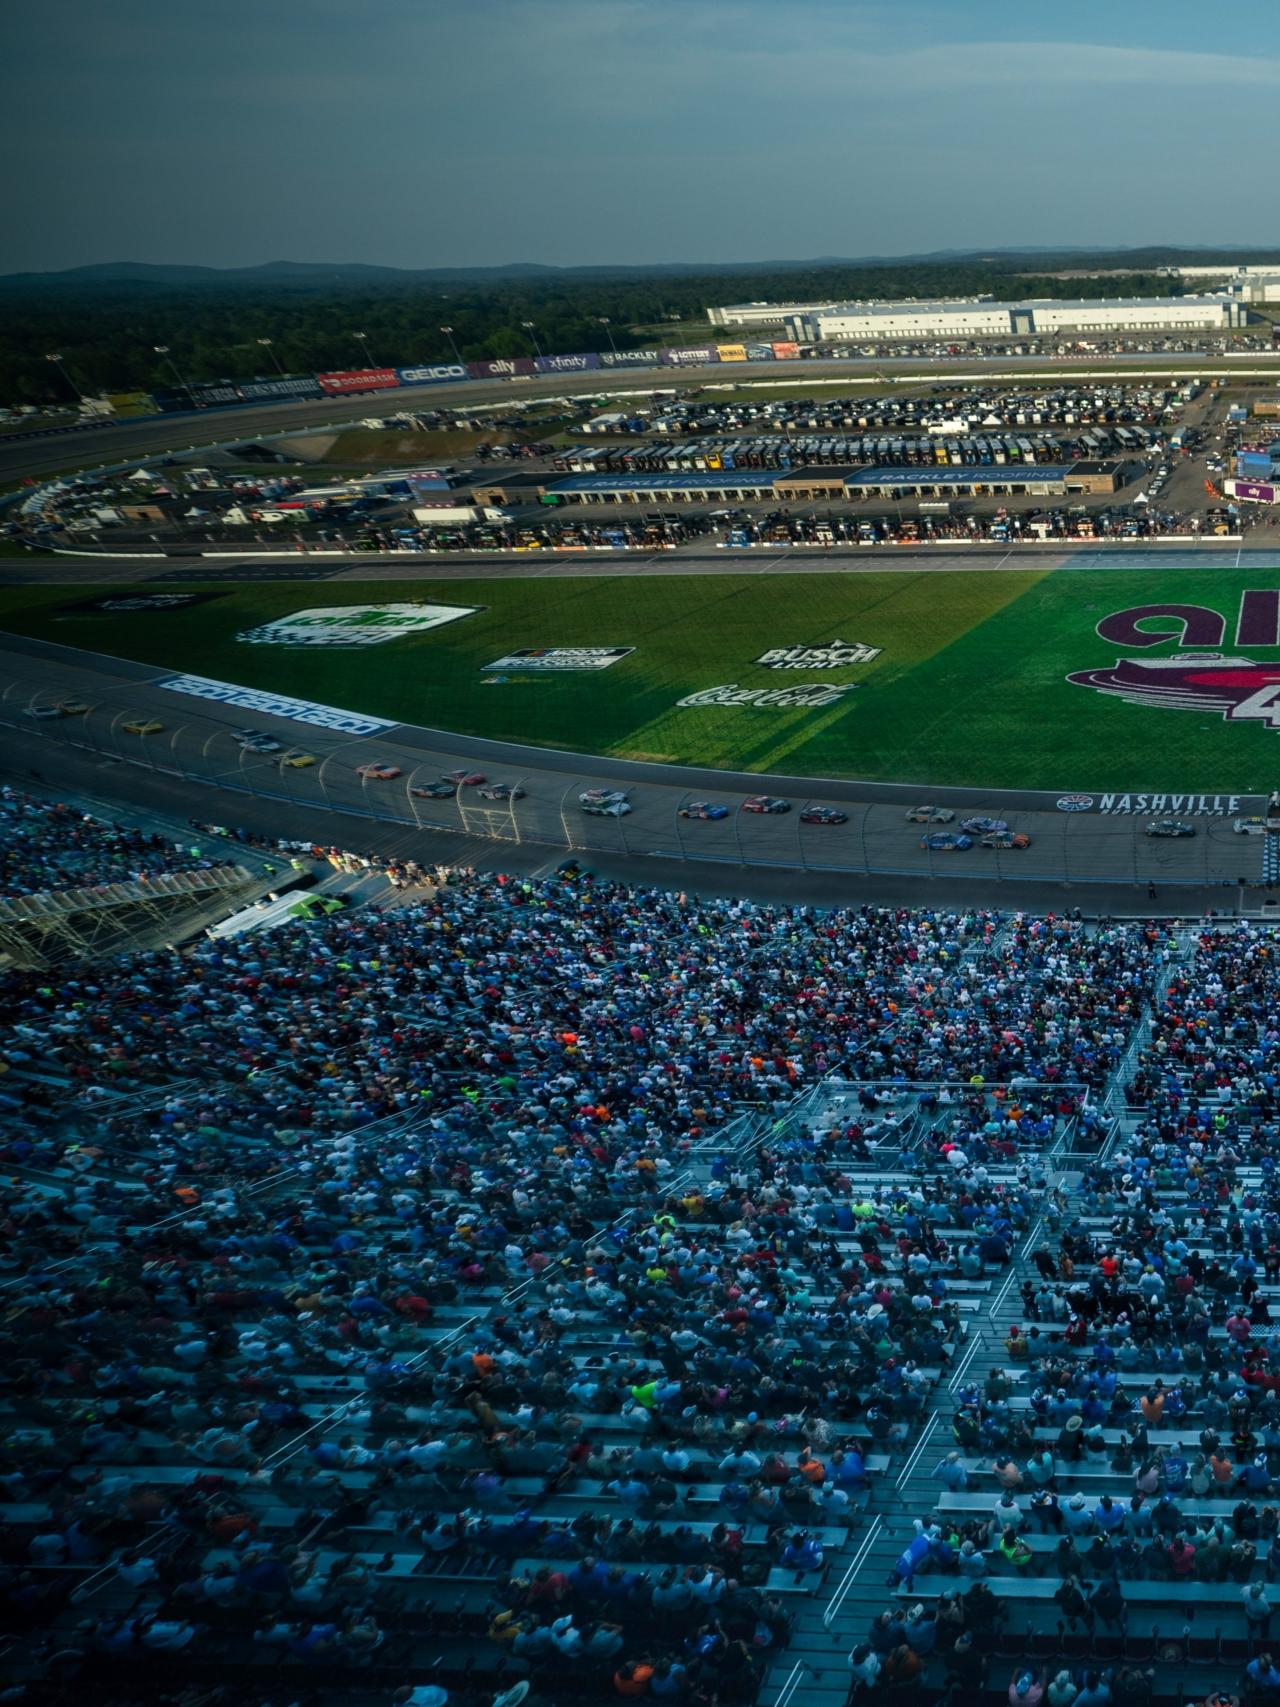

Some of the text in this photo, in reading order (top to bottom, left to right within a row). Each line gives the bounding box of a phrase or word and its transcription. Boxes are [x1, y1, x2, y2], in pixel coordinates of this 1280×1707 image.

[615, 351, 657, 361] RACKLEY
[678, 350, 710, 358] LOTTERY
[488, 360, 515, 374] ally
[550, 356, 586, 370] xfinity
[402, 365, 465, 381] GEICO
[592, 477, 767, 487] RACKLEY ROOFING
[880, 471, 1059, 481] RACKLEY ROOFING
[277, 610, 440, 627] LOTTERY
[754, 648, 882, 663] BUSCH
[771, 661, 847, 669] LIGHT
[159, 678, 381, 735] GEICO GEICO GEICO
[1100, 793, 1241, 811] NASHVILLE
[1100, 809, 1236, 817] SUPERSPEEDWAY
